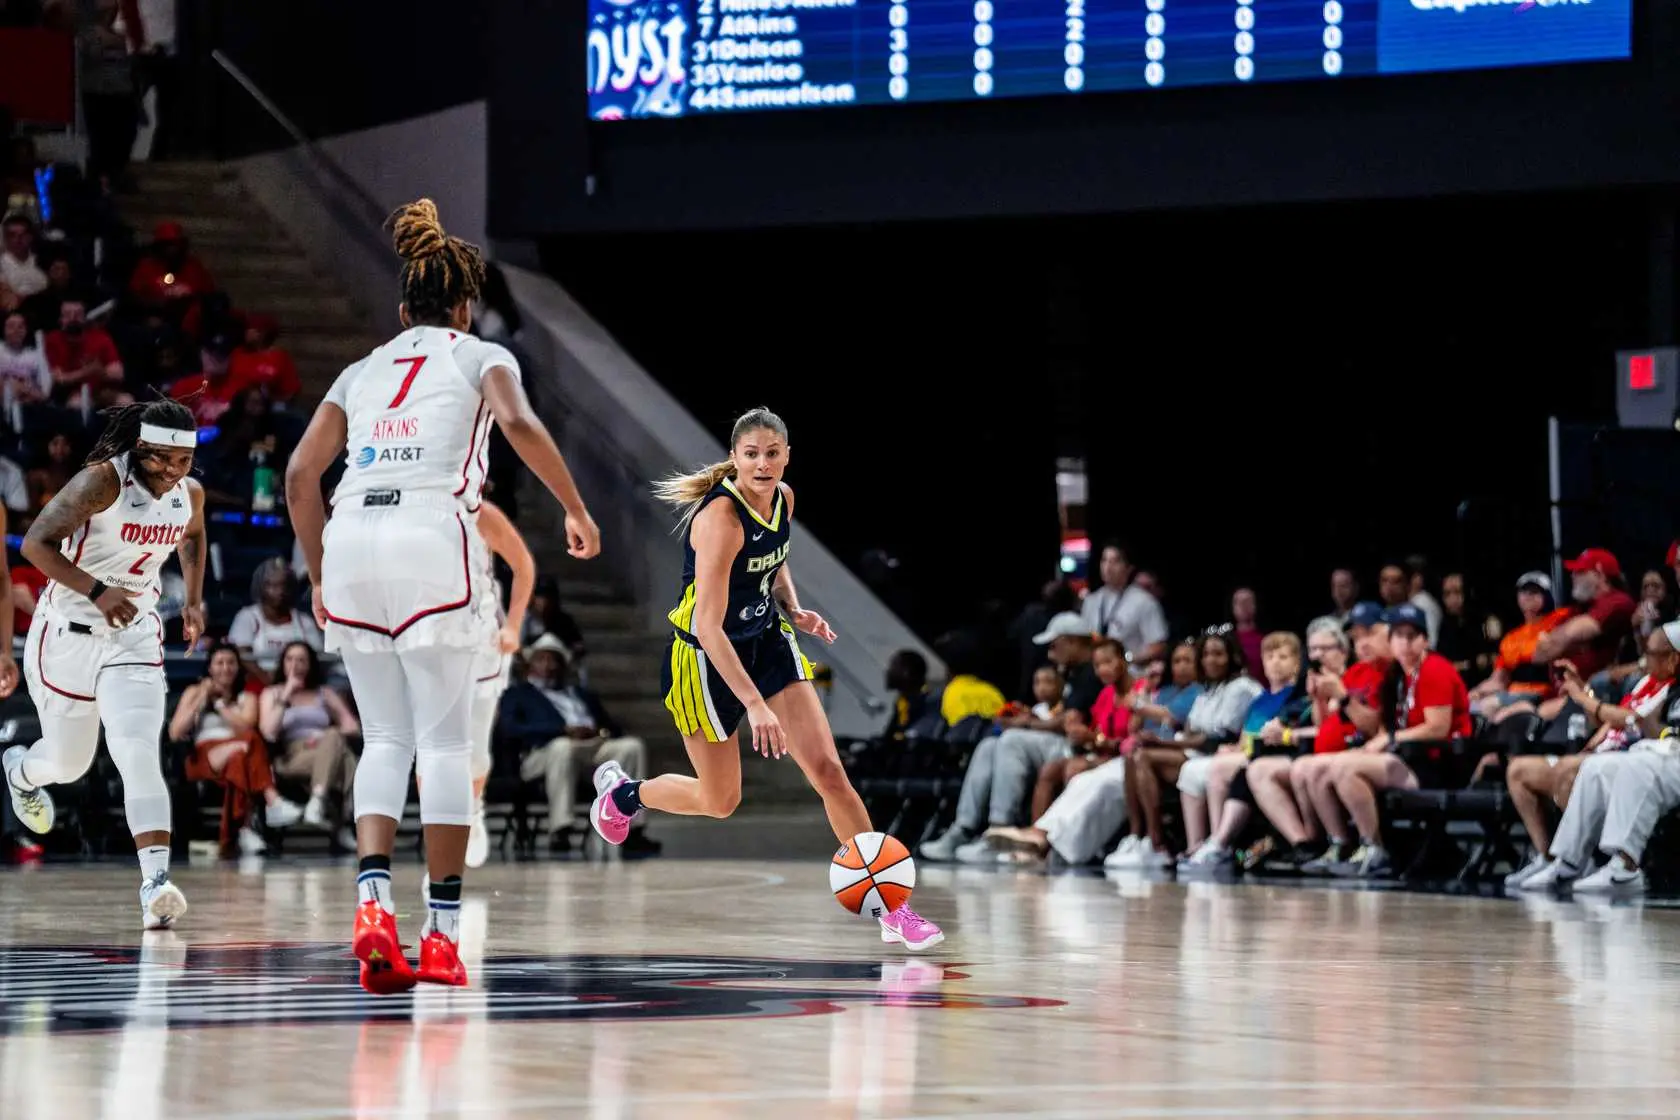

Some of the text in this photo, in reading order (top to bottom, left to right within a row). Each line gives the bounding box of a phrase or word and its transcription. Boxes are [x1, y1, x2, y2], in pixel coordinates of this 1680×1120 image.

[698, 16, 714, 38] 7
[718, 14, 796, 36] Atkins
[387, 354, 429, 410] 7
[371, 416, 419, 441] ATKINS
[378, 446, 425, 463] AT&T
[127, 551, 153, 576] 2
